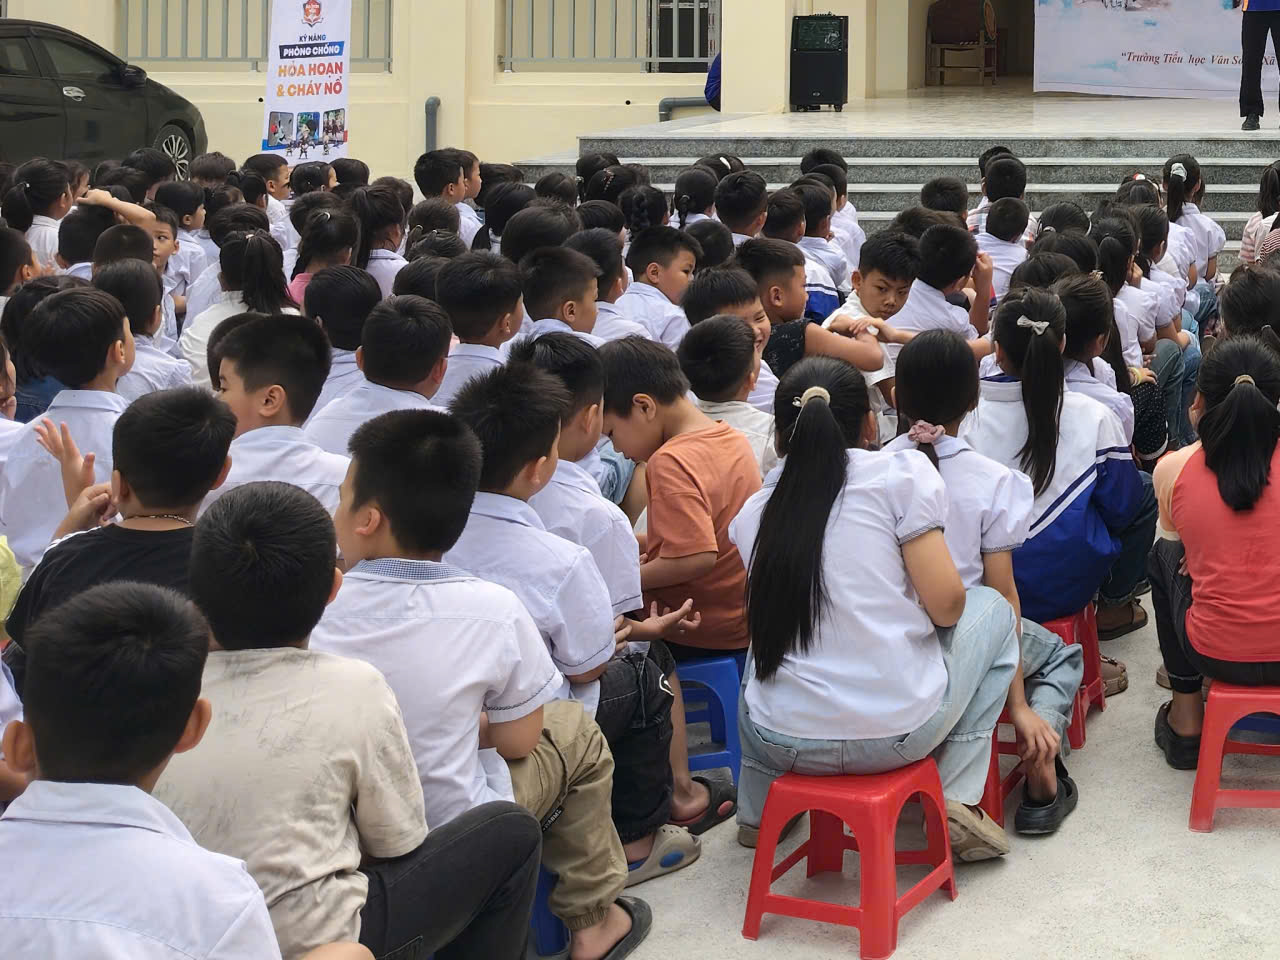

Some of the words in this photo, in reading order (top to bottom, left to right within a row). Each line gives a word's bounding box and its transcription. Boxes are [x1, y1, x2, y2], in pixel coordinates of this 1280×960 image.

[299, 34, 308, 42] KỸ
[308, 33, 326, 41] NĂNG
[283, 45, 312, 57] PHÒNG
[312, 42, 340, 55] CHỐNG
[1163, 51, 1183, 64] Tiểu
[1188, 54, 1206, 66] học
[308, 61, 344, 79] HOẠN
[276, 84, 285, 97] &
[287, 80, 322, 97] CHÁY
[324, 75, 343, 95] NỔ
